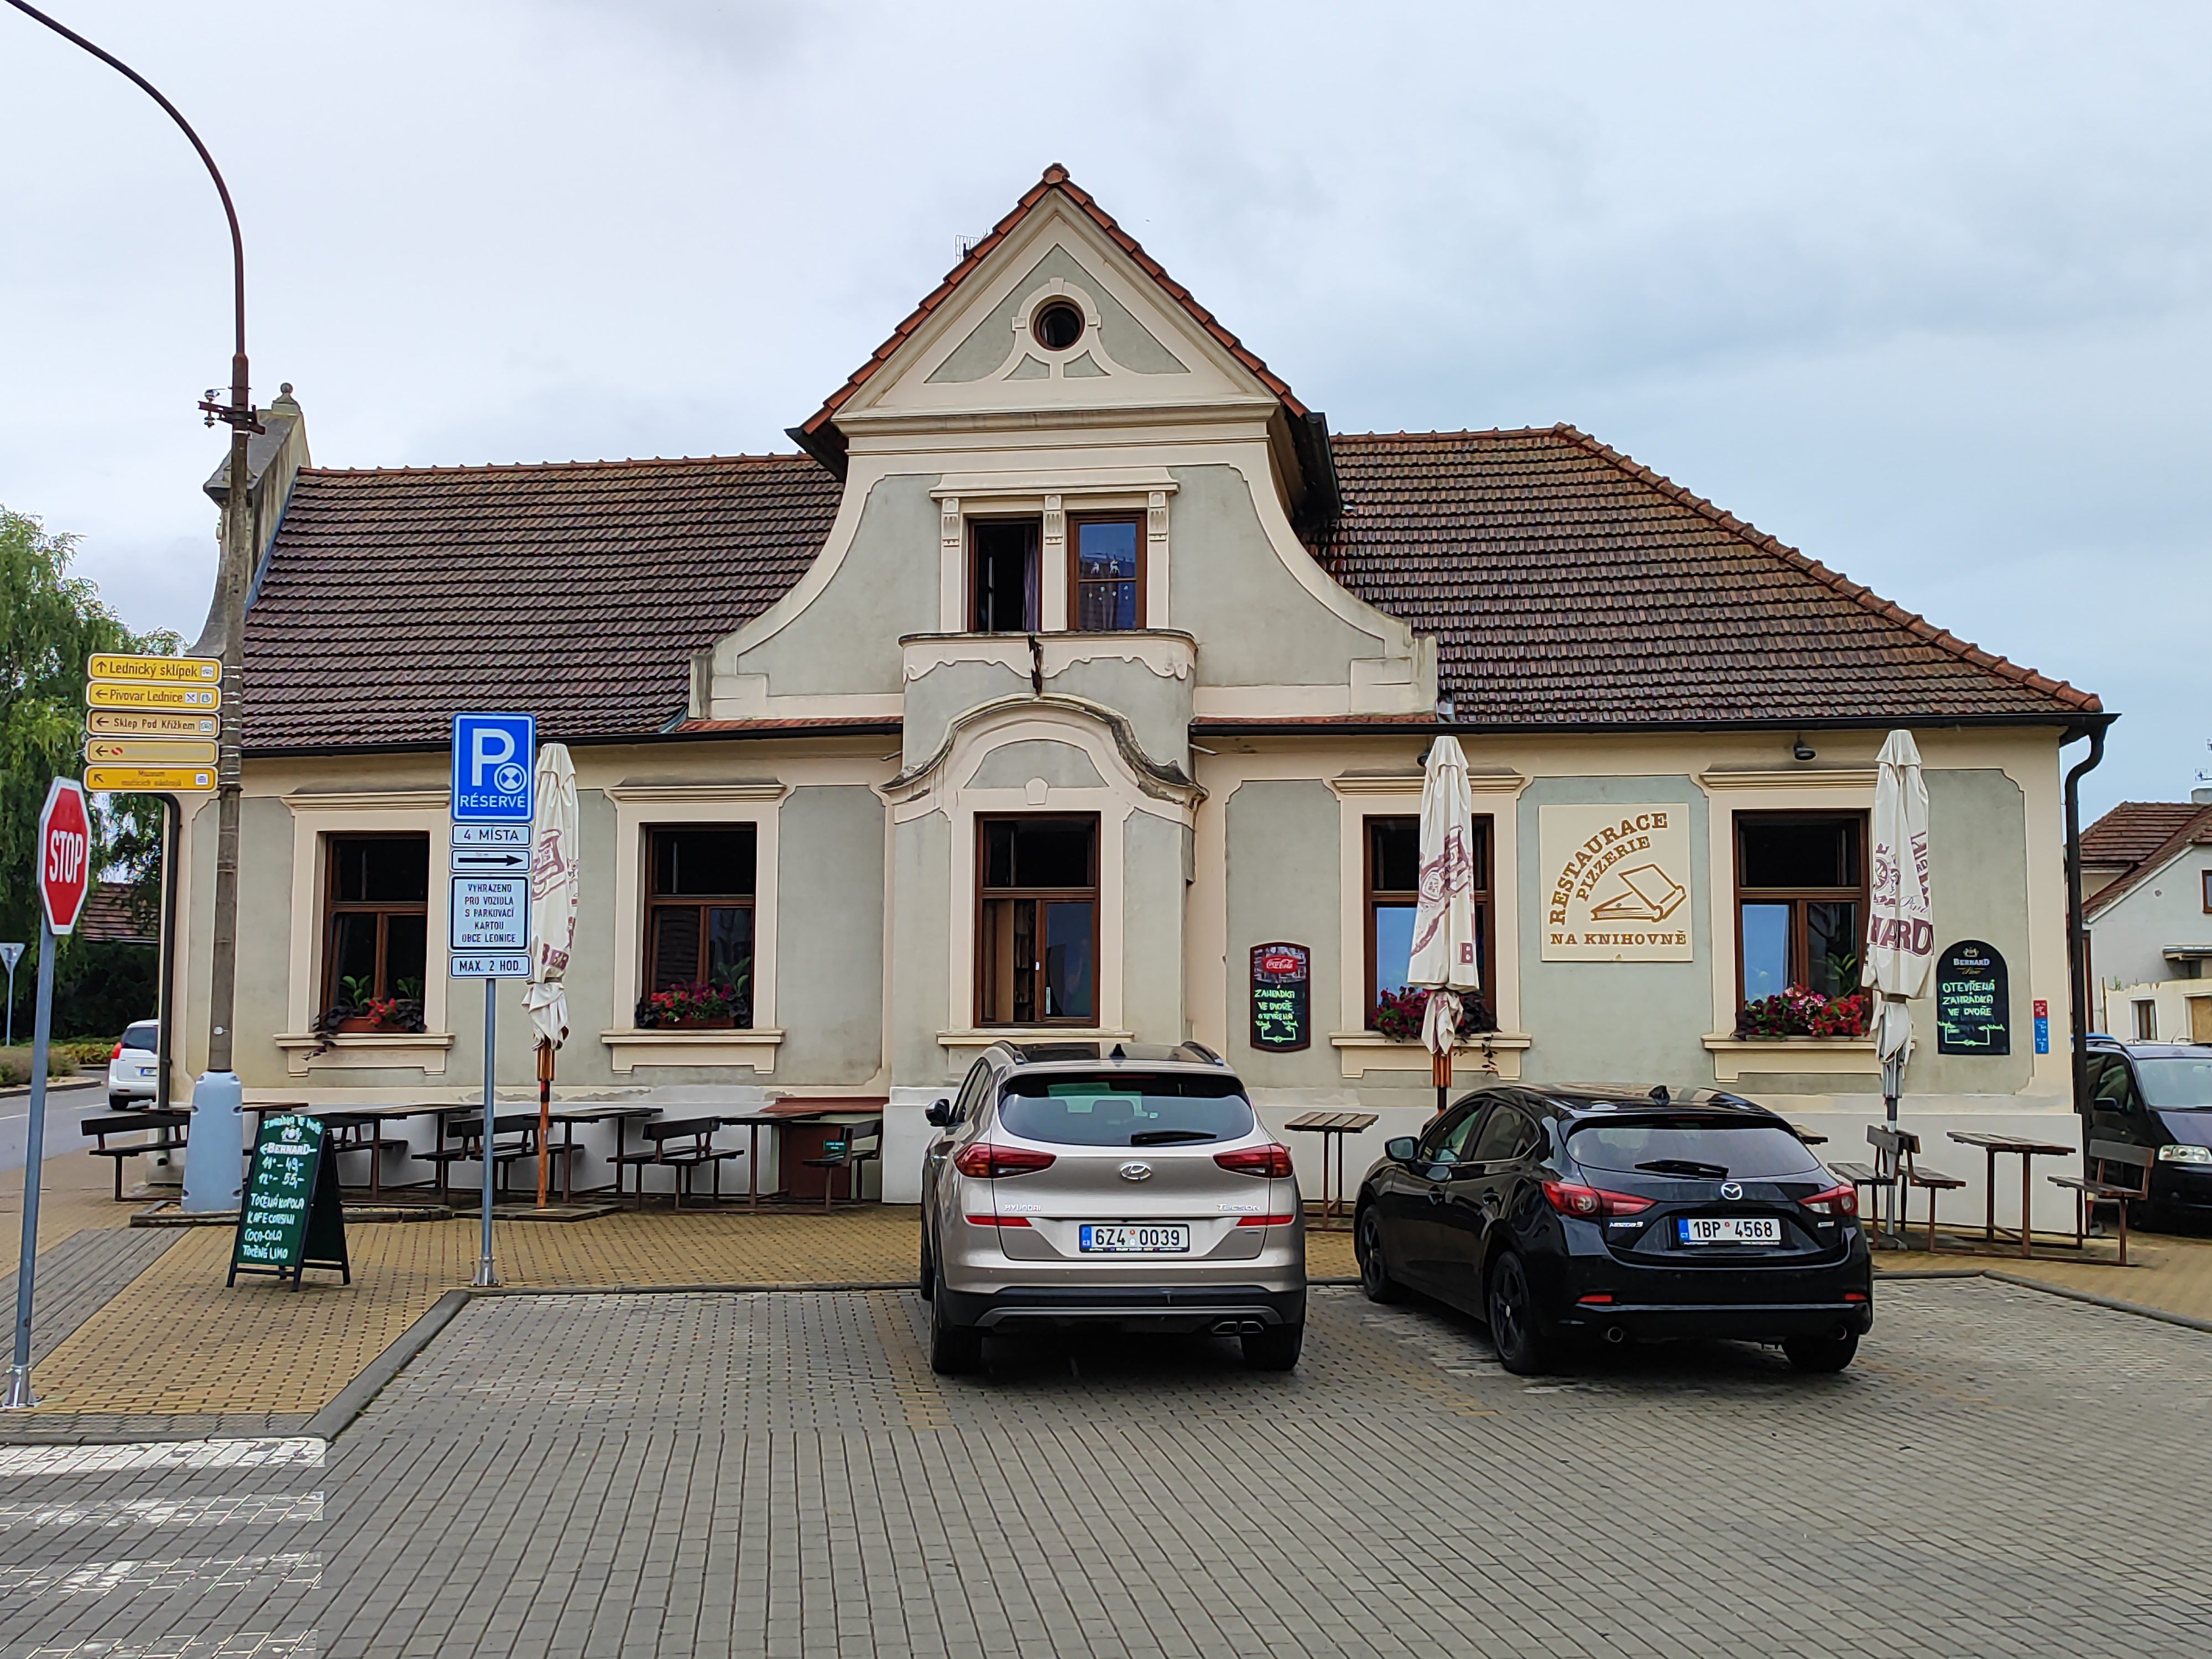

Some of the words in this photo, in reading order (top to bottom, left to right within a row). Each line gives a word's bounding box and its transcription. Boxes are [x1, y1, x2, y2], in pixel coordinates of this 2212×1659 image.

[109, 661, 157, 678] Lednický
[160, 664, 198, 679] sklípek
[110, 689, 144, 701] Pivovar
[147, 691, 183, 702] Lednice
[114, 718, 137, 729] Sklep
[142, 719, 157, 728] Pod
[161, 719, 195, 729] Křížkem
[472, 728, 515, 786] P
[460, 792, 526, 807] RÉSERVÉ
[464, 829, 471, 840] 4
[479, 827, 519, 841] MÍSTA
[49, 830, 84, 884] STOP
[1550, 812, 1668, 926] RESTAURACE
[1575, 836, 1651, 902] PIZZERIE
[468, 884, 512, 893] VYHRAZENO
[465, 896, 479, 905] PRO
[483, 896, 514, 905] VOZIDLA
[465, 909, 470, 917] S
[474, 907, 514, 917] PARKOVACÍ
[474, 921, 504, 930] KARTOU
[462, 934, 481, 942] OBCE
[485, 934, 516, 942] LEDNICE
[1550, 933, 1578, 945] NA
[1584, 930, 1687, 945] KNIHOVNĚ
[460, 960, 484, 972] MAX.
[489, 960, 494, 971] 2
[500, 960, 521, 972] HOD.
[1953, 958, 1990, 966] BERNARD
[1964, 1005, 1992, 1016] DVOŘE
[267, 1142, 310, 1155] BERNARD
[1694, 1220, 1720, 1238] 1BP
[1735, 1220, 1773, 1238] 4568
[1095, 1229, 1125, 1245] 6Z4
[1139, 1229, 1180, 1245] 0039
